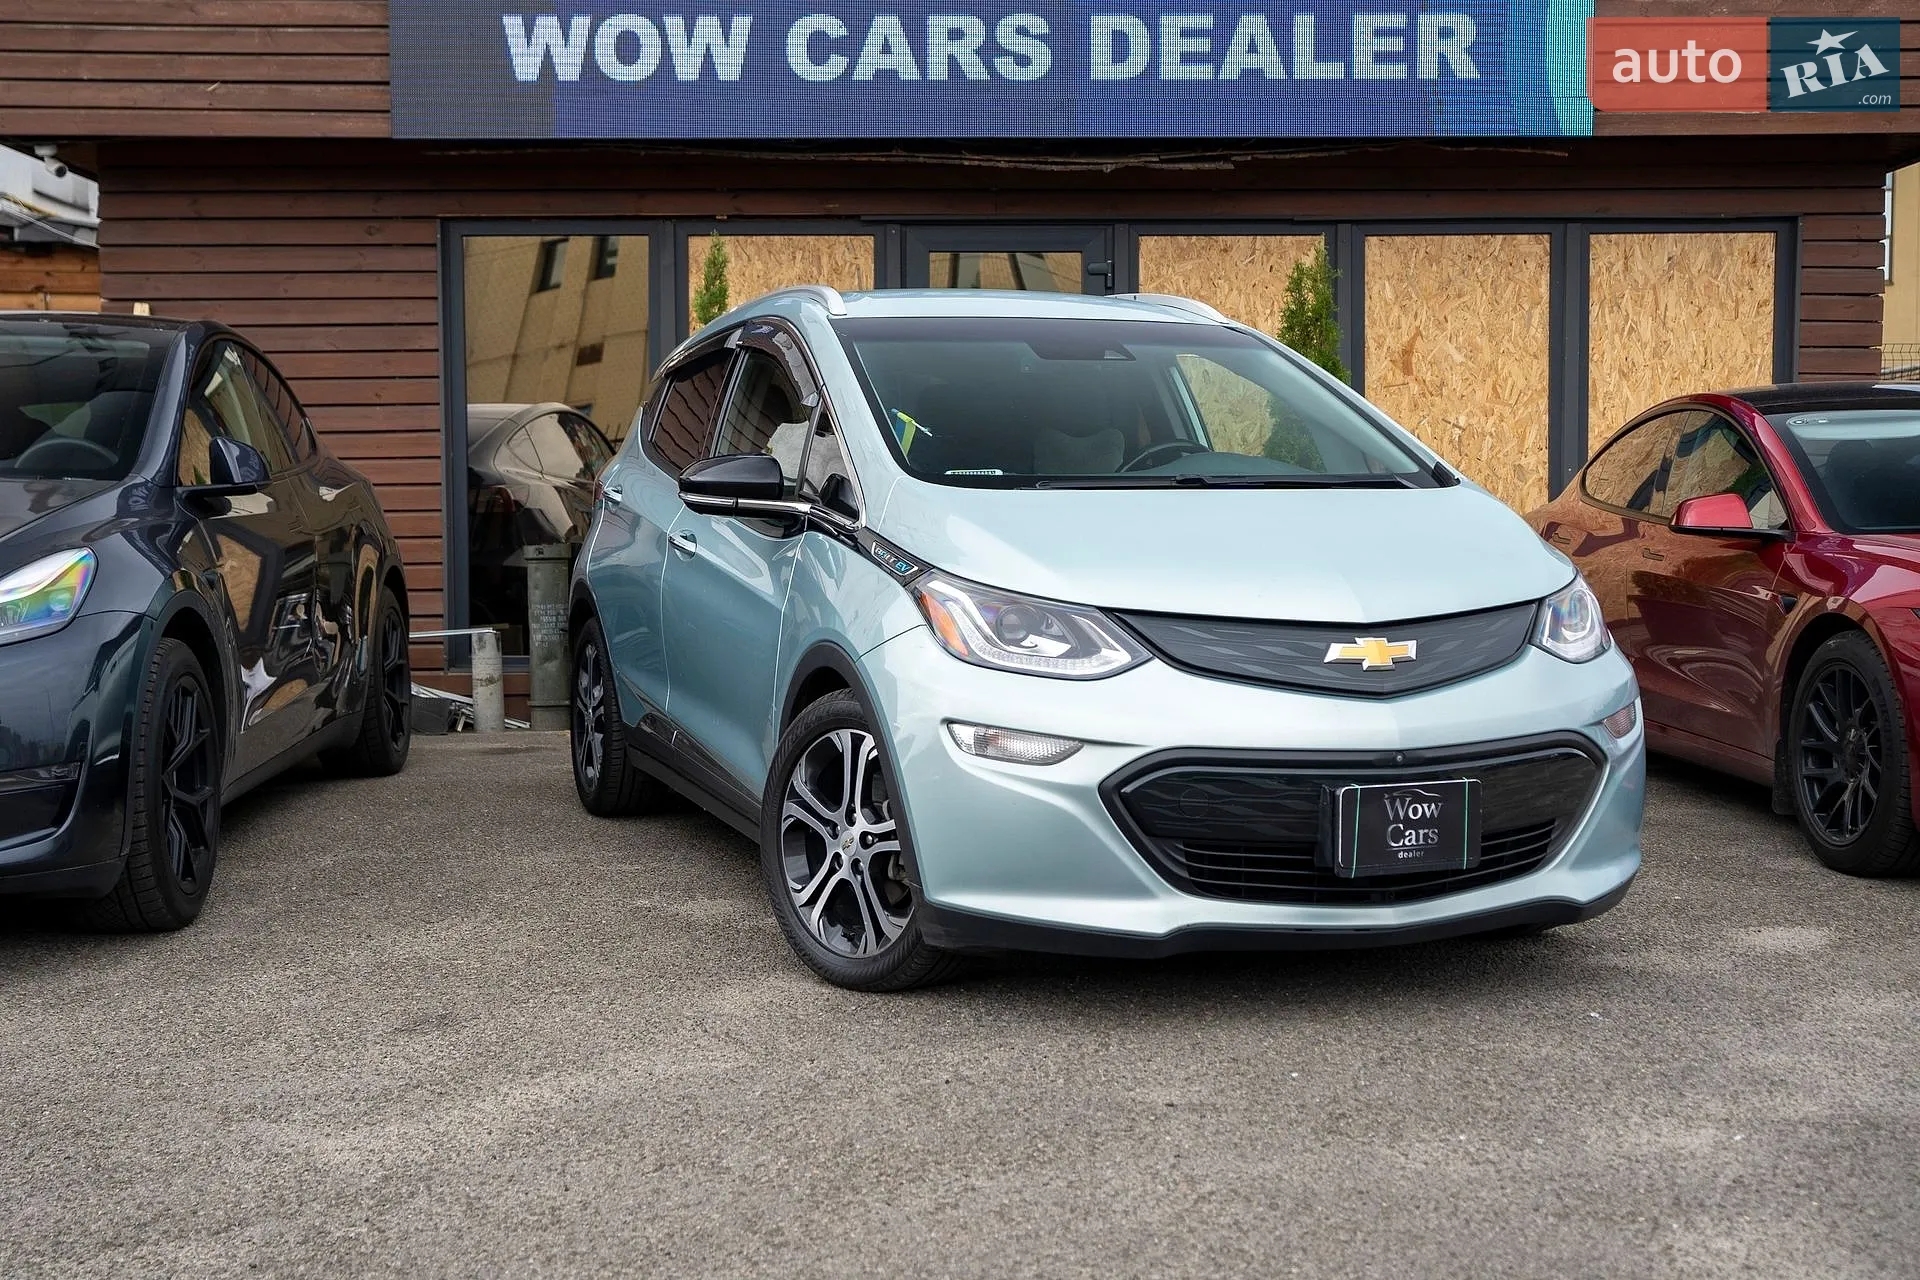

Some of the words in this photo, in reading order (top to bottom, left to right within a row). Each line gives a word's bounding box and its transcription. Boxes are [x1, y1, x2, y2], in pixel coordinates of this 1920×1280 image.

[501, 13, 753, 83] WOW
[785, 12, 1053, 83] CARS
[1089, 12, 1481, 81] DEALER
[895, 561, 910, 571] EV
[1385, 798, 1443, 821] Wow
[1386, 823, 1439, 847] Cars
[1397, 850, 1424, 859] dealer
